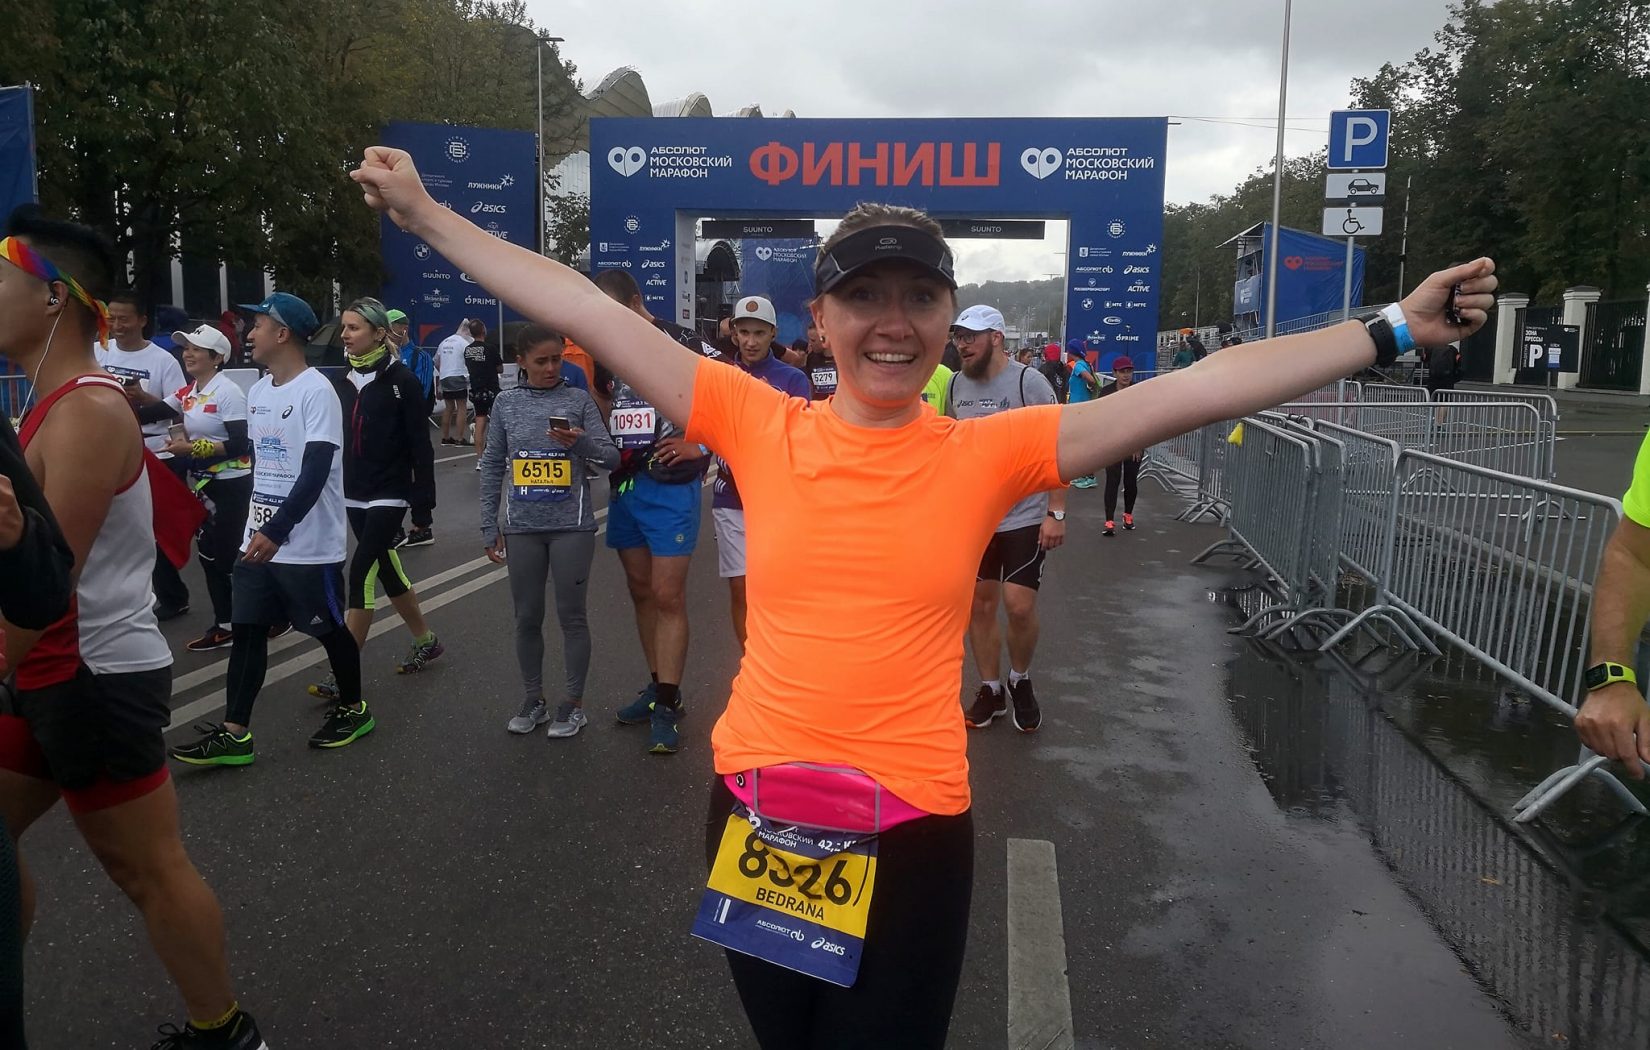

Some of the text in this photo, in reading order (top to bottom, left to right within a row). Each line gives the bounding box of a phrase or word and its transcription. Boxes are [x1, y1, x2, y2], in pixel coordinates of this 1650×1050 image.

[1344, 117, 1378, 162] P
[650, 146, 707, 155] АБСОЛЮТ
[1066, 147, 1128, 156] АБСОЛЮТ
[650, 155, 732, 167] МОСКОВСКИЙ
[749, 141, 1001, 186] ФИНИШ
[1065, 156, 1154, 169] МОСКОВСКИЙ
[650, 168, 708, 178] МАРАФОН
[1065, 170, 1128, 180] МАРАФОН
[467, 181, 503, 190] ЛУЖНИКИ
[422, 272, 451, 280] SUUNTO
[814, 373, 833, 382] 5279
[613, 412, 652, 430] 10931
[521, 462, 563, 478] 6515
[758, 831, 797, 848] МАРАФОН
[755, 887, 824, 920] BEDRANA
[757, 920, 791, 935] АБСОЛЮТ
